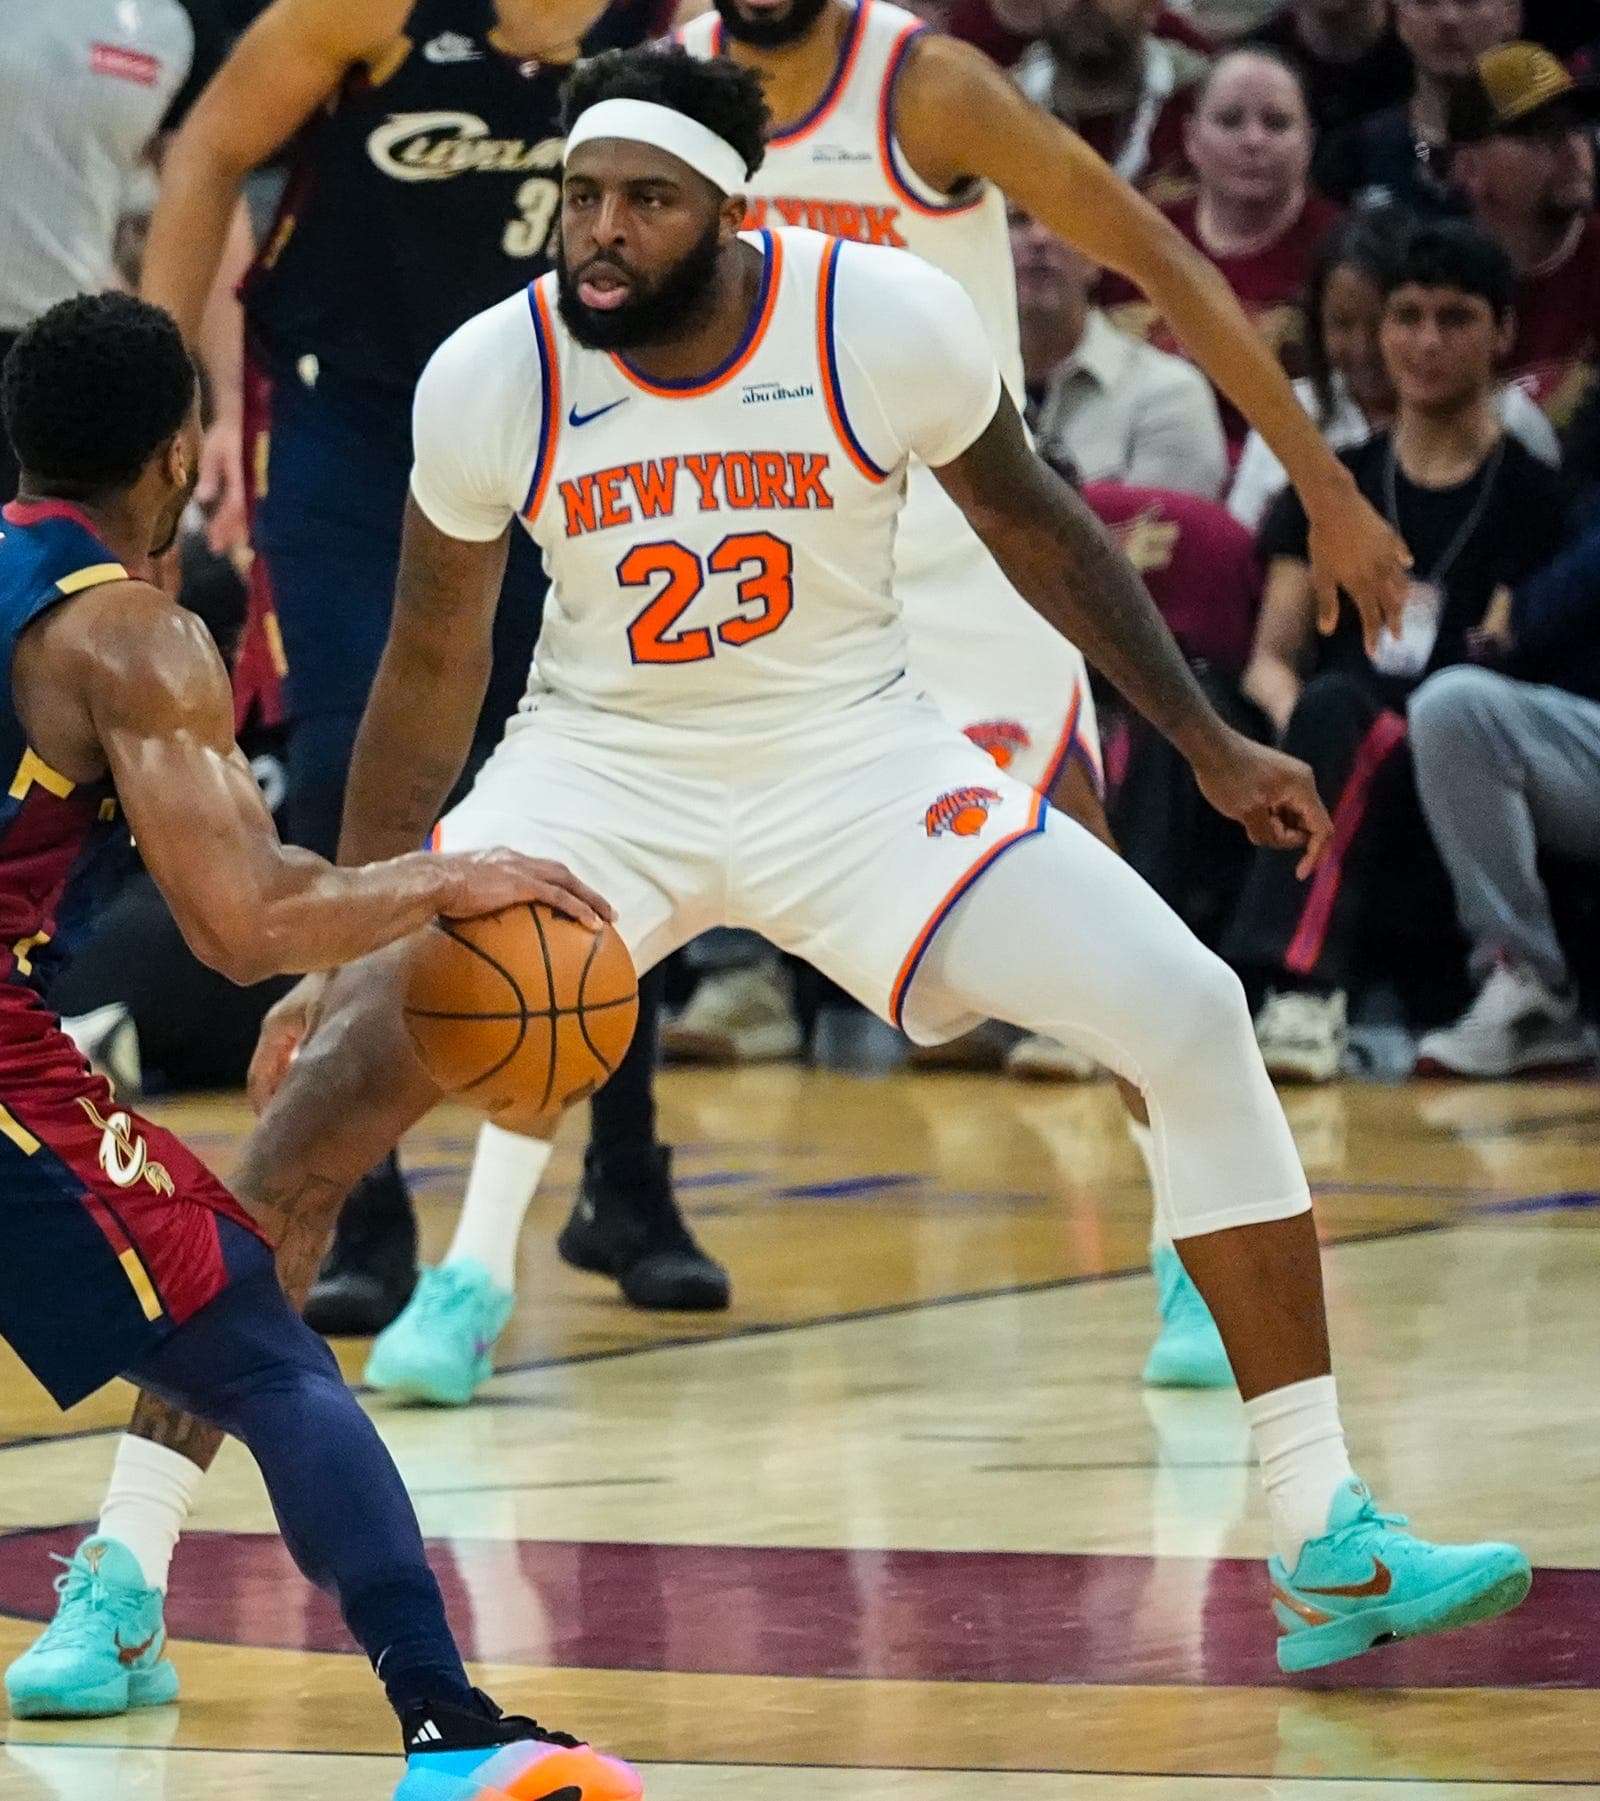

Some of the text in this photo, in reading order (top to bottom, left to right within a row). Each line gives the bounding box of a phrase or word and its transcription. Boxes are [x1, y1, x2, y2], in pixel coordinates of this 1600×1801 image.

[742, 387, 769, 403] abu
[772, 384, 814, 400] dhabi
[557, 450, 834, 538] NEW YORK
[616, 531, 793, 664] 23
